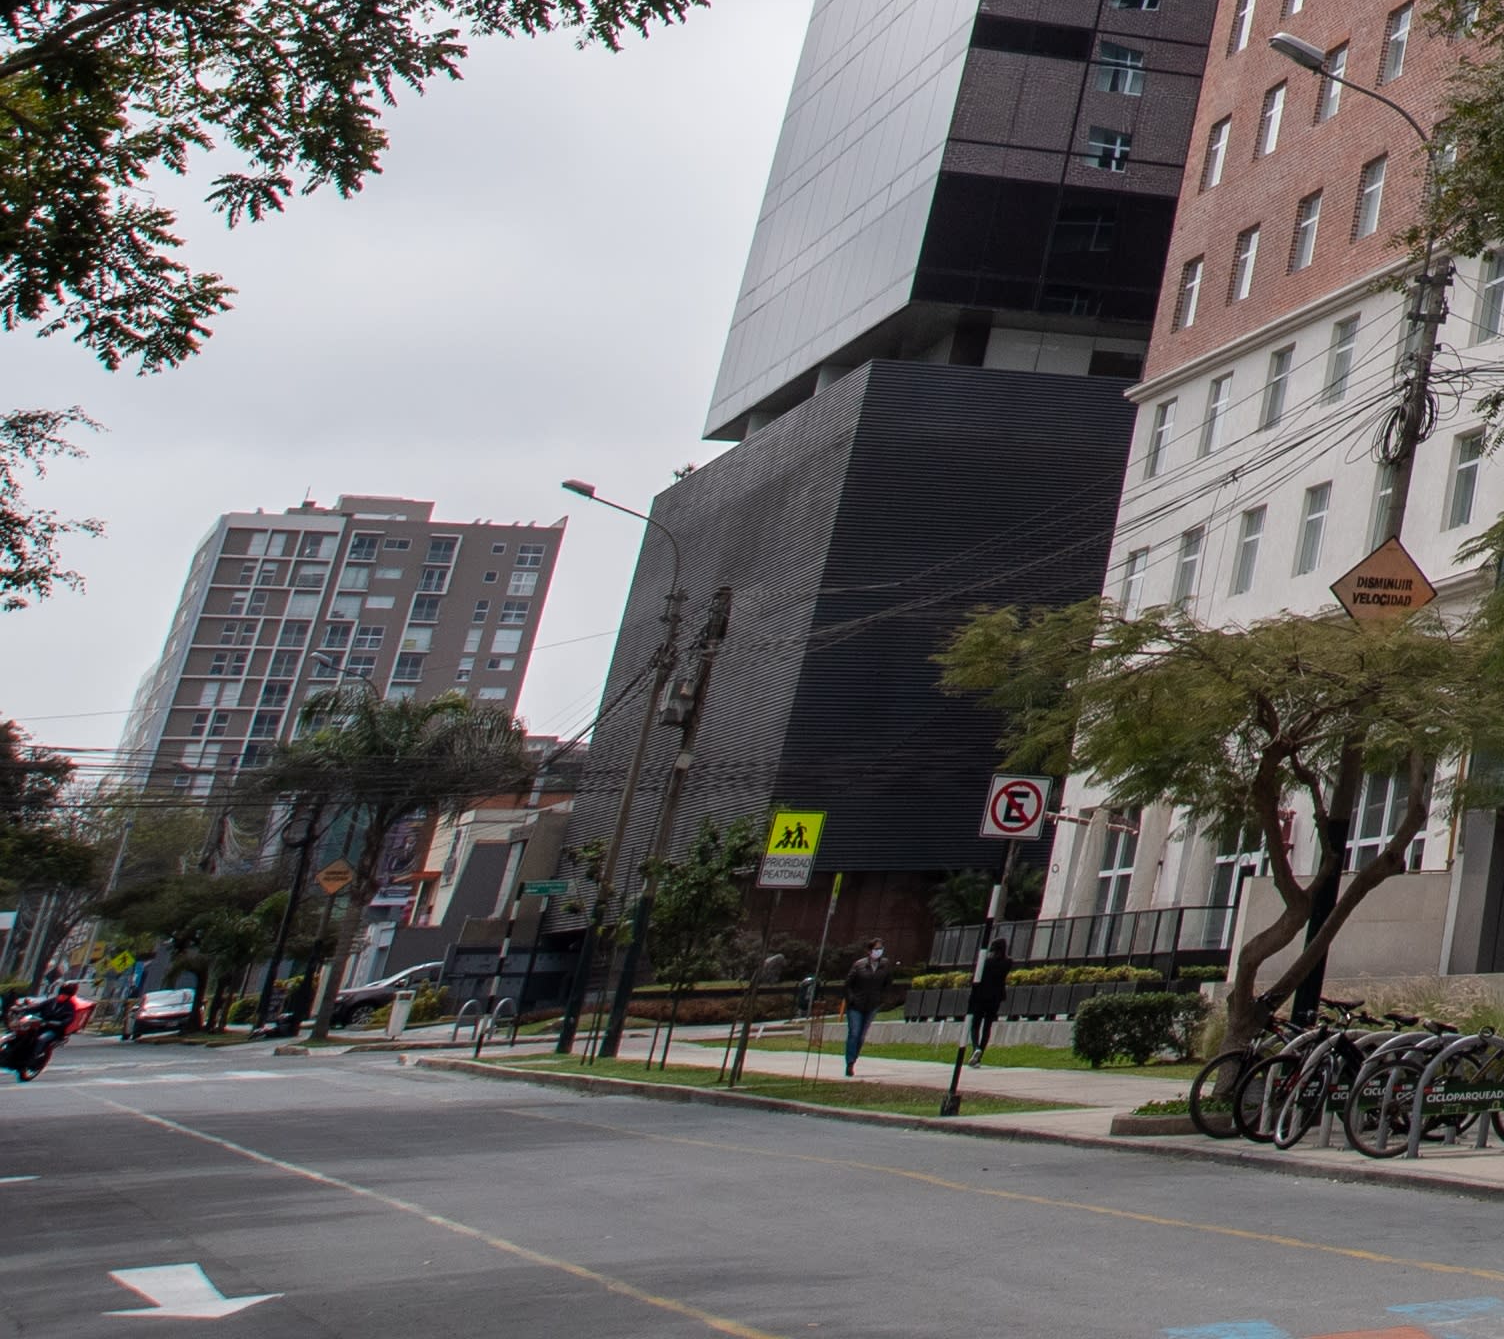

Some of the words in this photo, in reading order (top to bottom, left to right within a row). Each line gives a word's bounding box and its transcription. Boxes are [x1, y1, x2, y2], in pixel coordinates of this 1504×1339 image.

[1356, 575, 1414, 591] DISMINUIR
[1352, 592, 1413, 607] VELOCIDAD
[765, 857, 811, 868] PRIORIDAD
[762, 868, 806, 880] PEATONAL
